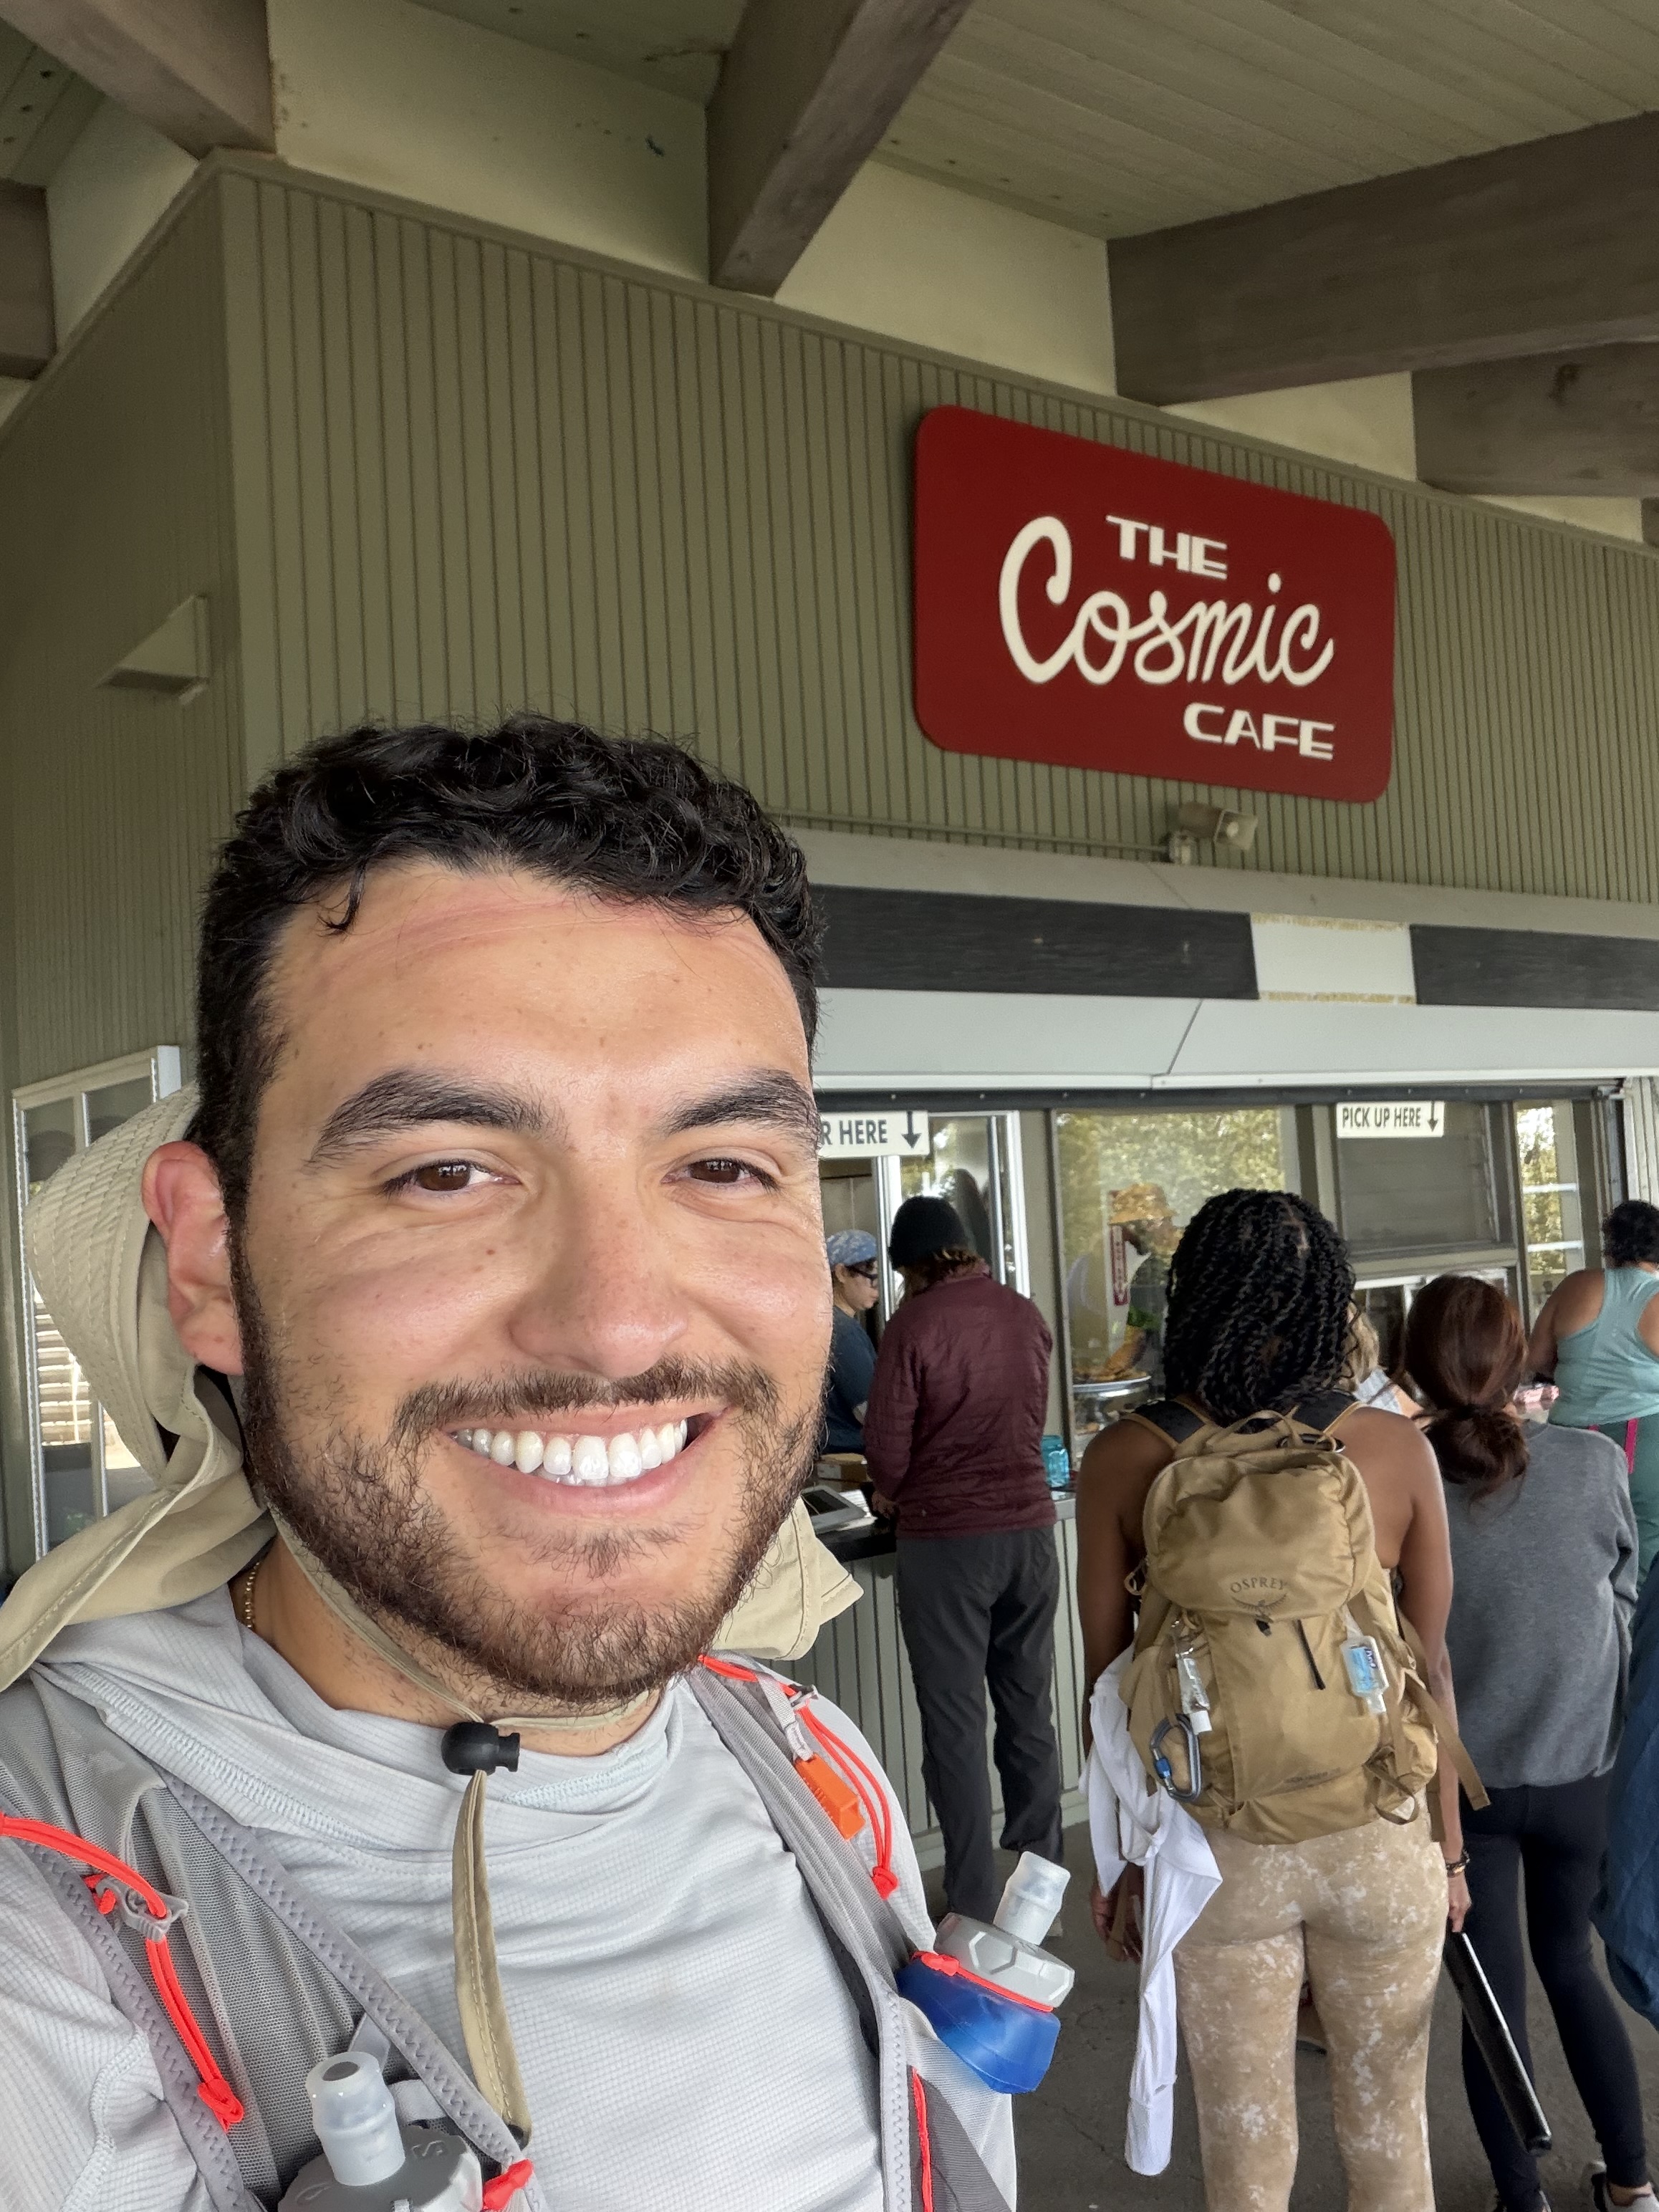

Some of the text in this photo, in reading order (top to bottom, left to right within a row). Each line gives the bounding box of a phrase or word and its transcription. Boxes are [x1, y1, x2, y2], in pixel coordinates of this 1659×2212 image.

[1106, 515, 1227, 580] THE
[999, 516, 1334, 686] Cosmic
[1184, 702, 1334, 760] CAFE
[821, 1120, 888, 1145] R HERE
[1342, 1107, 1421, 1128] PICK UP HERE
[1230, 1577, 1288, 1593] OSPREY
